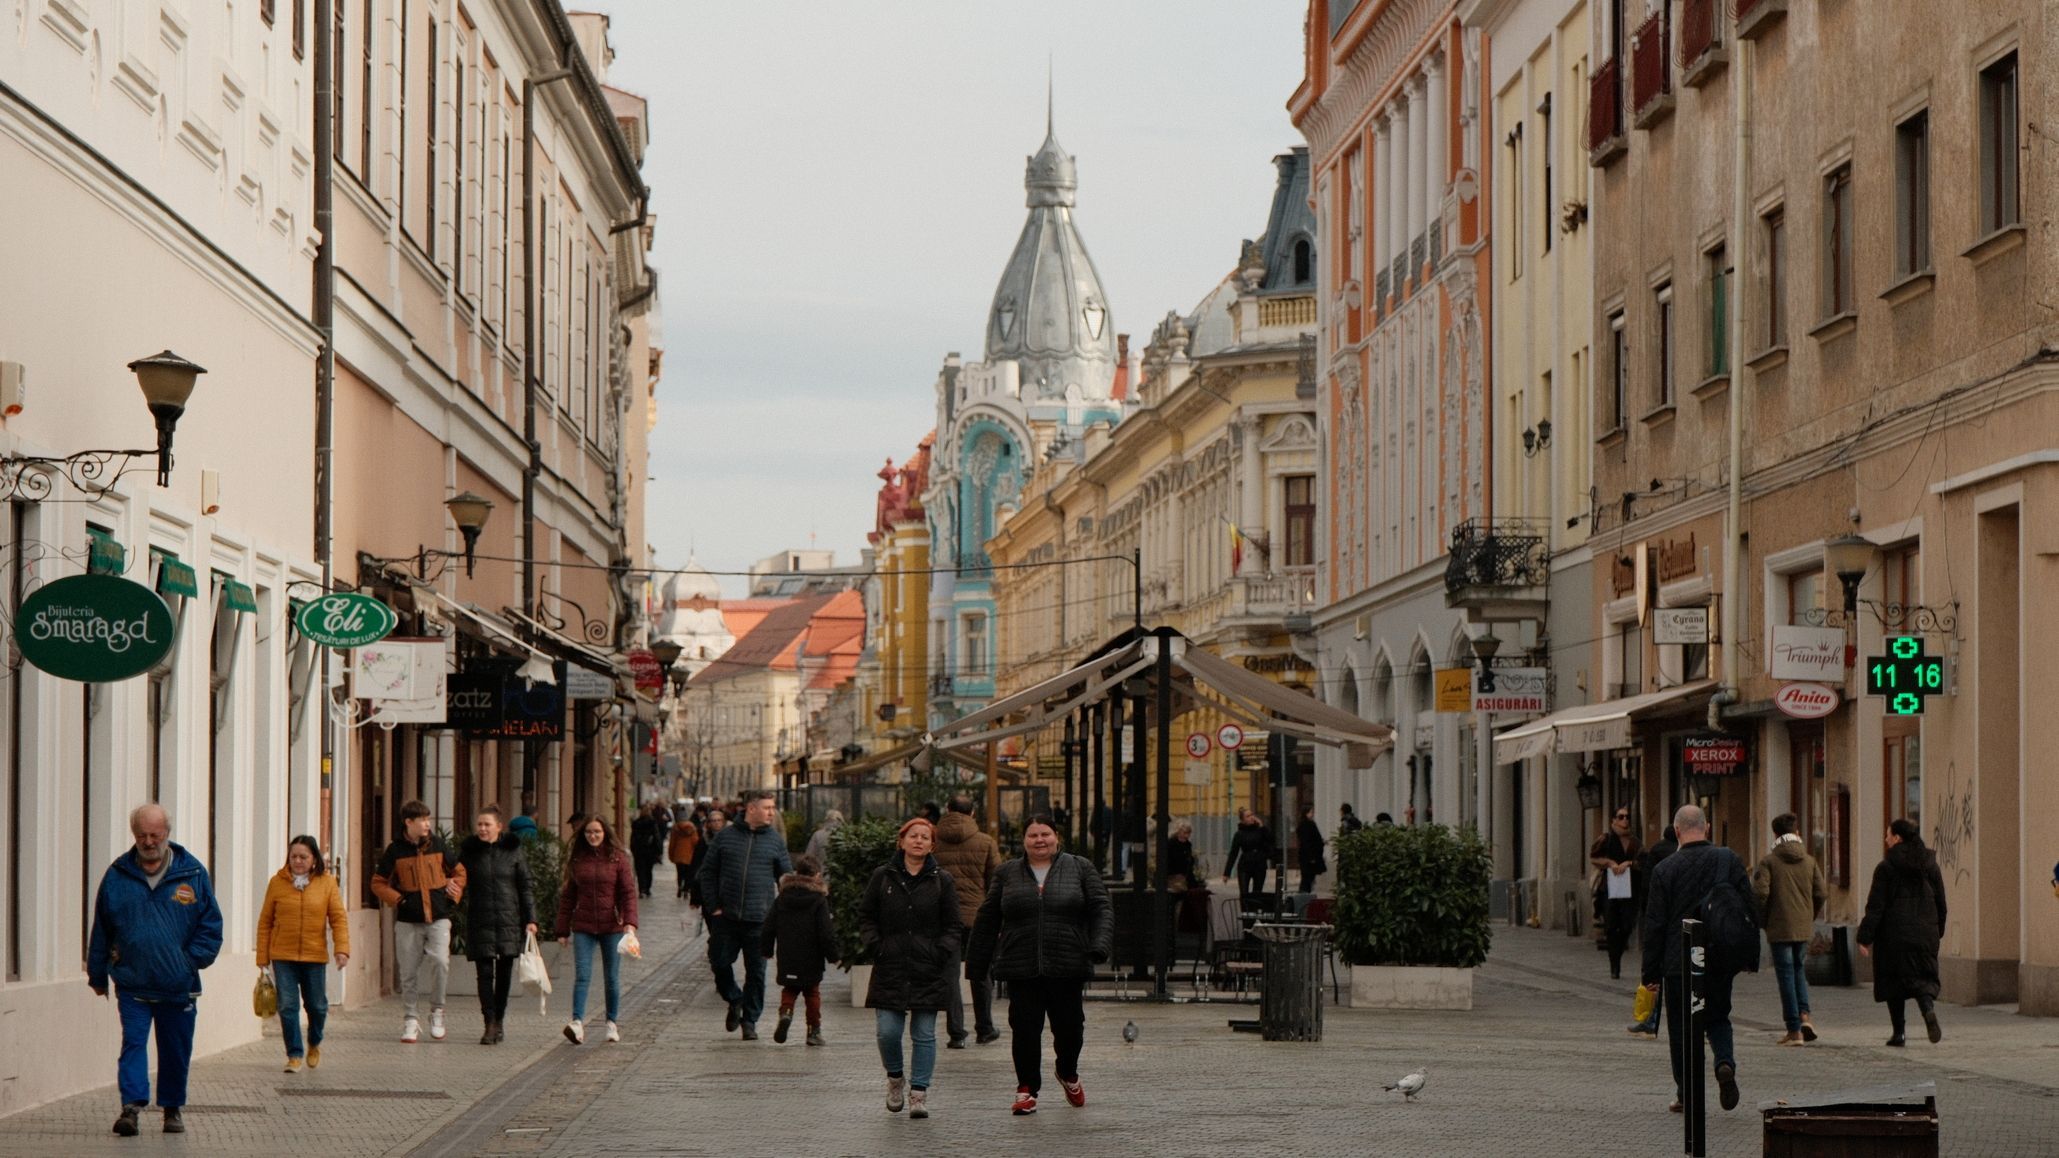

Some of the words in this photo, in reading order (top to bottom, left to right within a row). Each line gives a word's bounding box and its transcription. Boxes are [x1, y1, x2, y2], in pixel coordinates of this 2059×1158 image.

[47, 604, 94, 618] Bijuteria
[322, 597, 365, 635] Eli
[1672, 615, 1704, 625] Cyrano
[30, 610, 156, 652] Smaragd
[350, 636, 361, 646] DE
[361, 631, 377, 644] LUX
[1775, 643, 1841, 670] Triumph
[1872, 663, 1896, 688] 11
[1913, 663, 1940, 688] 16
[1476, 696, 1542, 710] ASIGURĂRI
[1783, 689, 1830, 704] Anita
[1691, 750, 1737, 760] XEROX
[1692, 762, 1736, 775] PRINT
